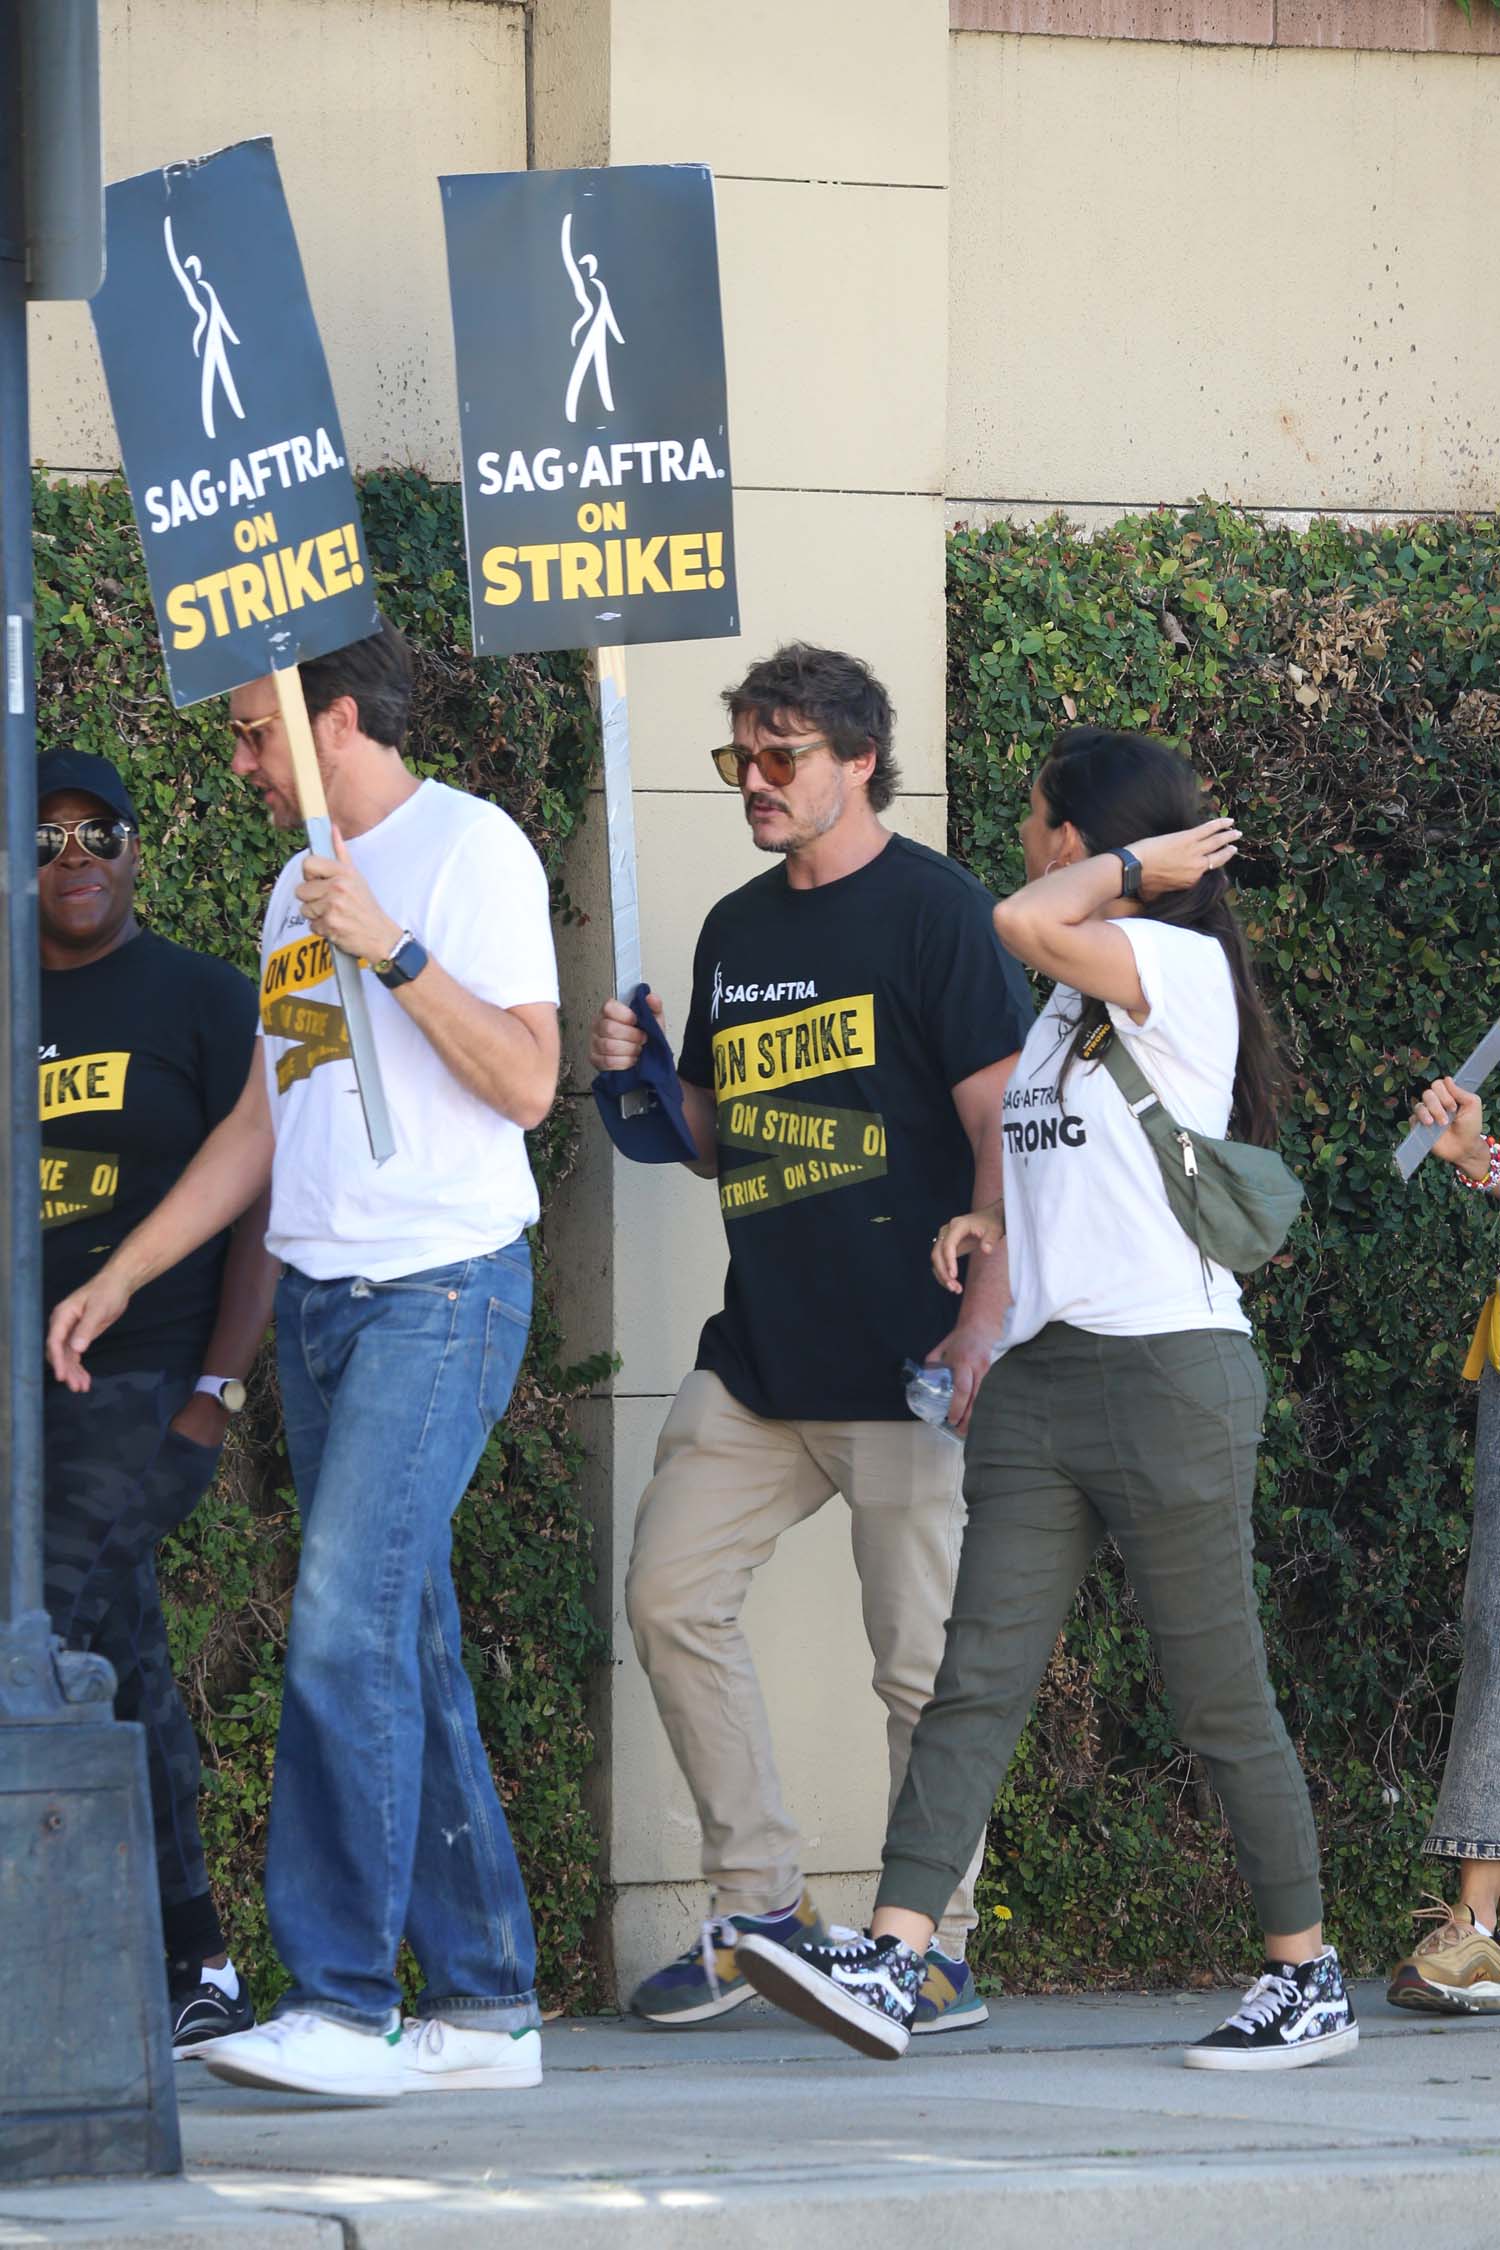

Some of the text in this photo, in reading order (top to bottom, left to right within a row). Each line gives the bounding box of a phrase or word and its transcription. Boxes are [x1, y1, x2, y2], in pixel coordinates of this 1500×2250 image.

[234, 512, 278, 553] ON
[577, 501, 627, 533] ON
[166, 523, 364, 650] STRIKE!
[482, 532, 725, 606] STRIKE!
[265, 937, 334, 994] ON STR
[715, 1009, 863, 1090] ON STRIKE
[44, 1061, 110, 1107] IKE
[730, 1103, 758, 1137] ON
[761, 1110, 838, 1150] STRIKE
[1001, 1115, 1087, 1154] TRONG
[783, 1163, 807, 1190] ON
